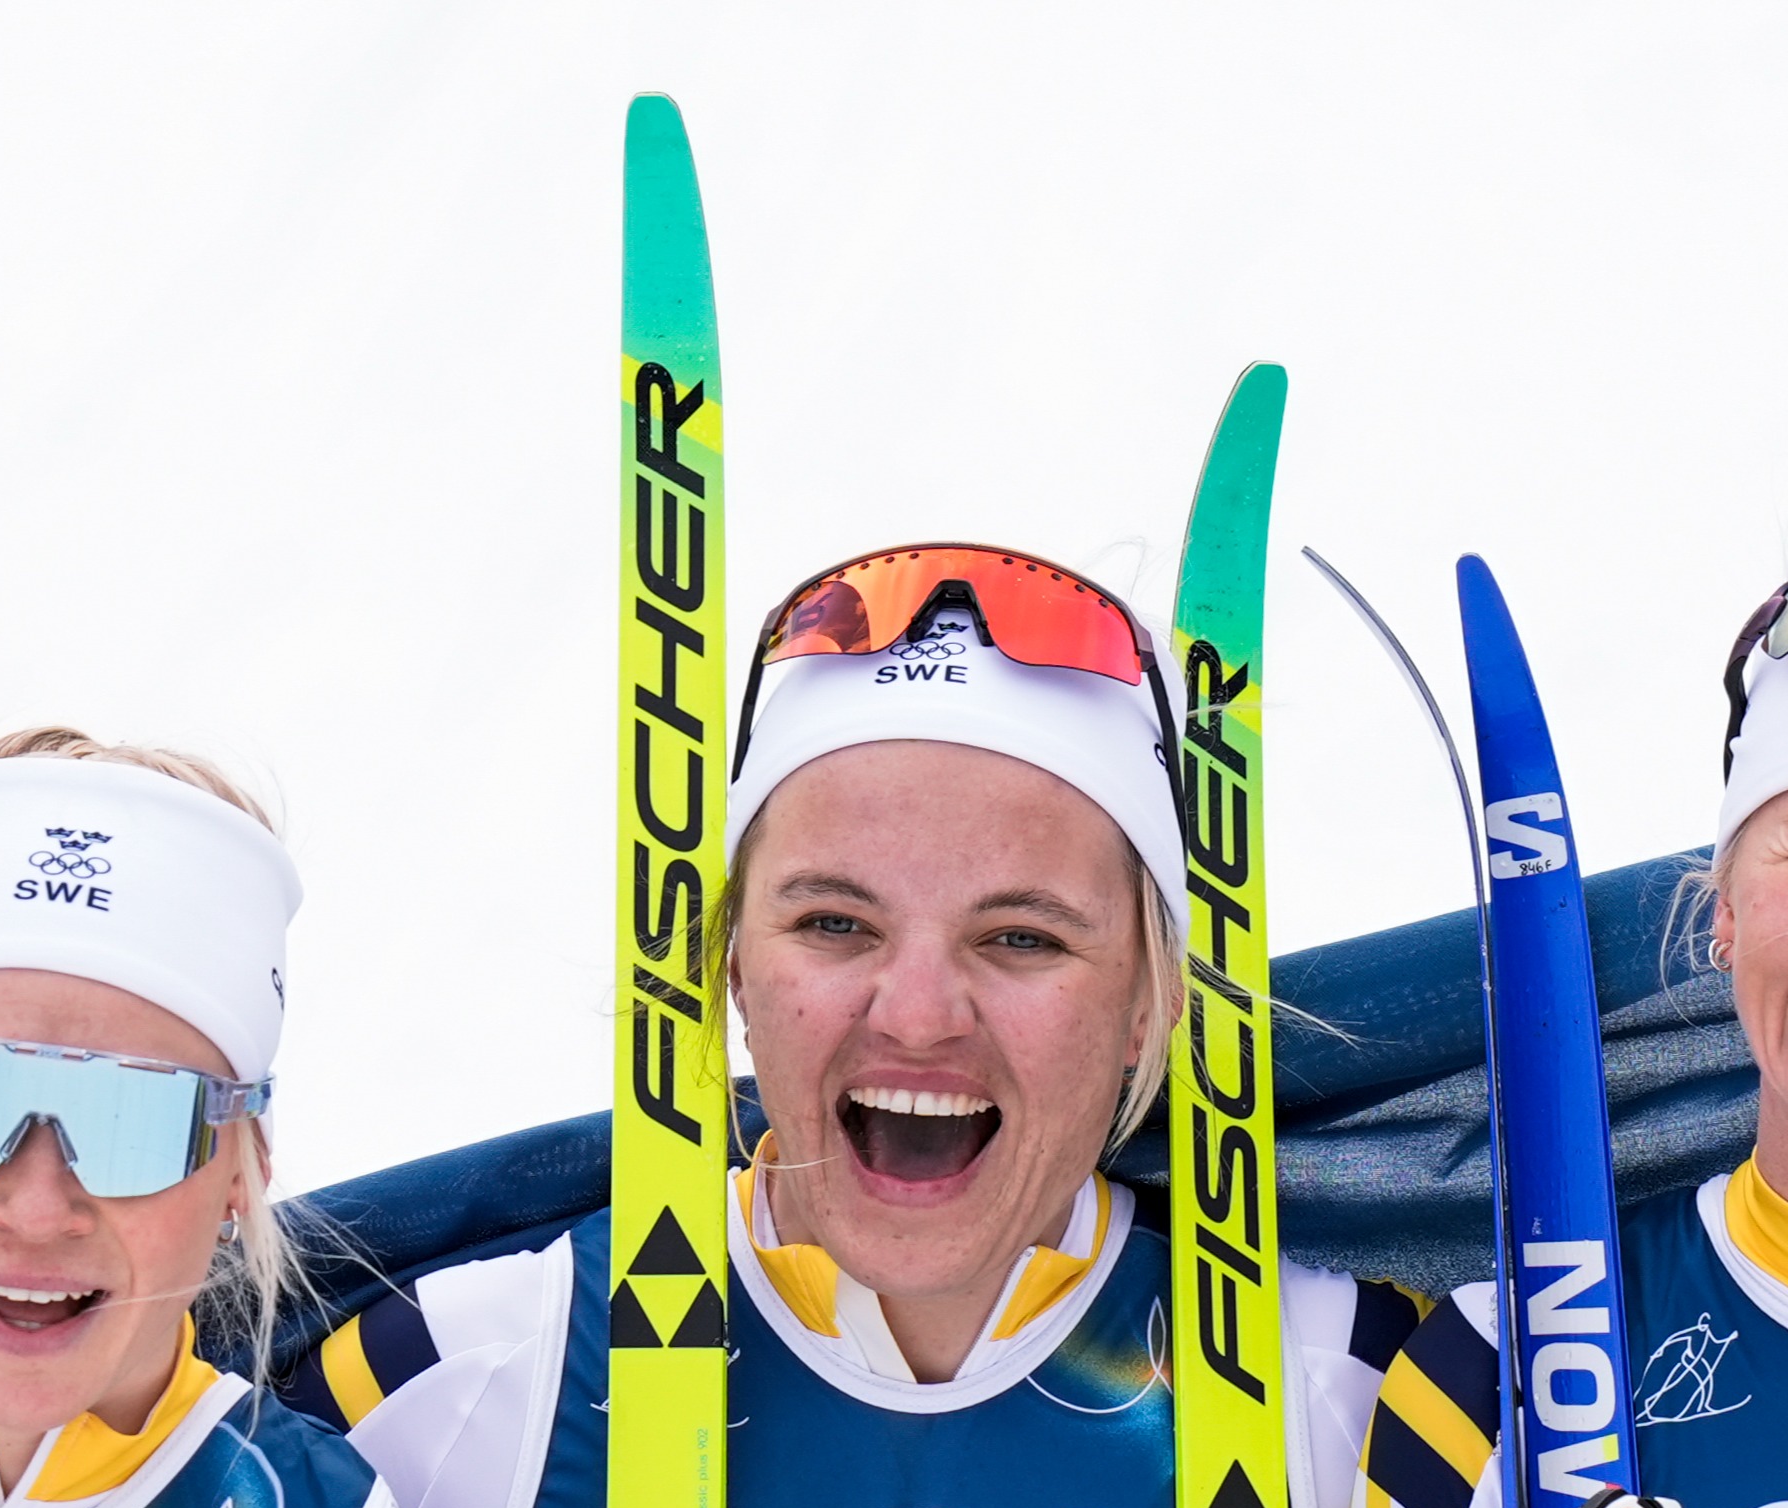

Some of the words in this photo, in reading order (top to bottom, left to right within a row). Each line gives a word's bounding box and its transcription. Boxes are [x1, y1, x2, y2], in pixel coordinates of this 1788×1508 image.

[633, 361, 705, 1147] FISCHER
[874, 664, 968, 684] SWE
[14, 879, 113, 911] SWE
[1185, 637, 1267, 1407] FISCHER
